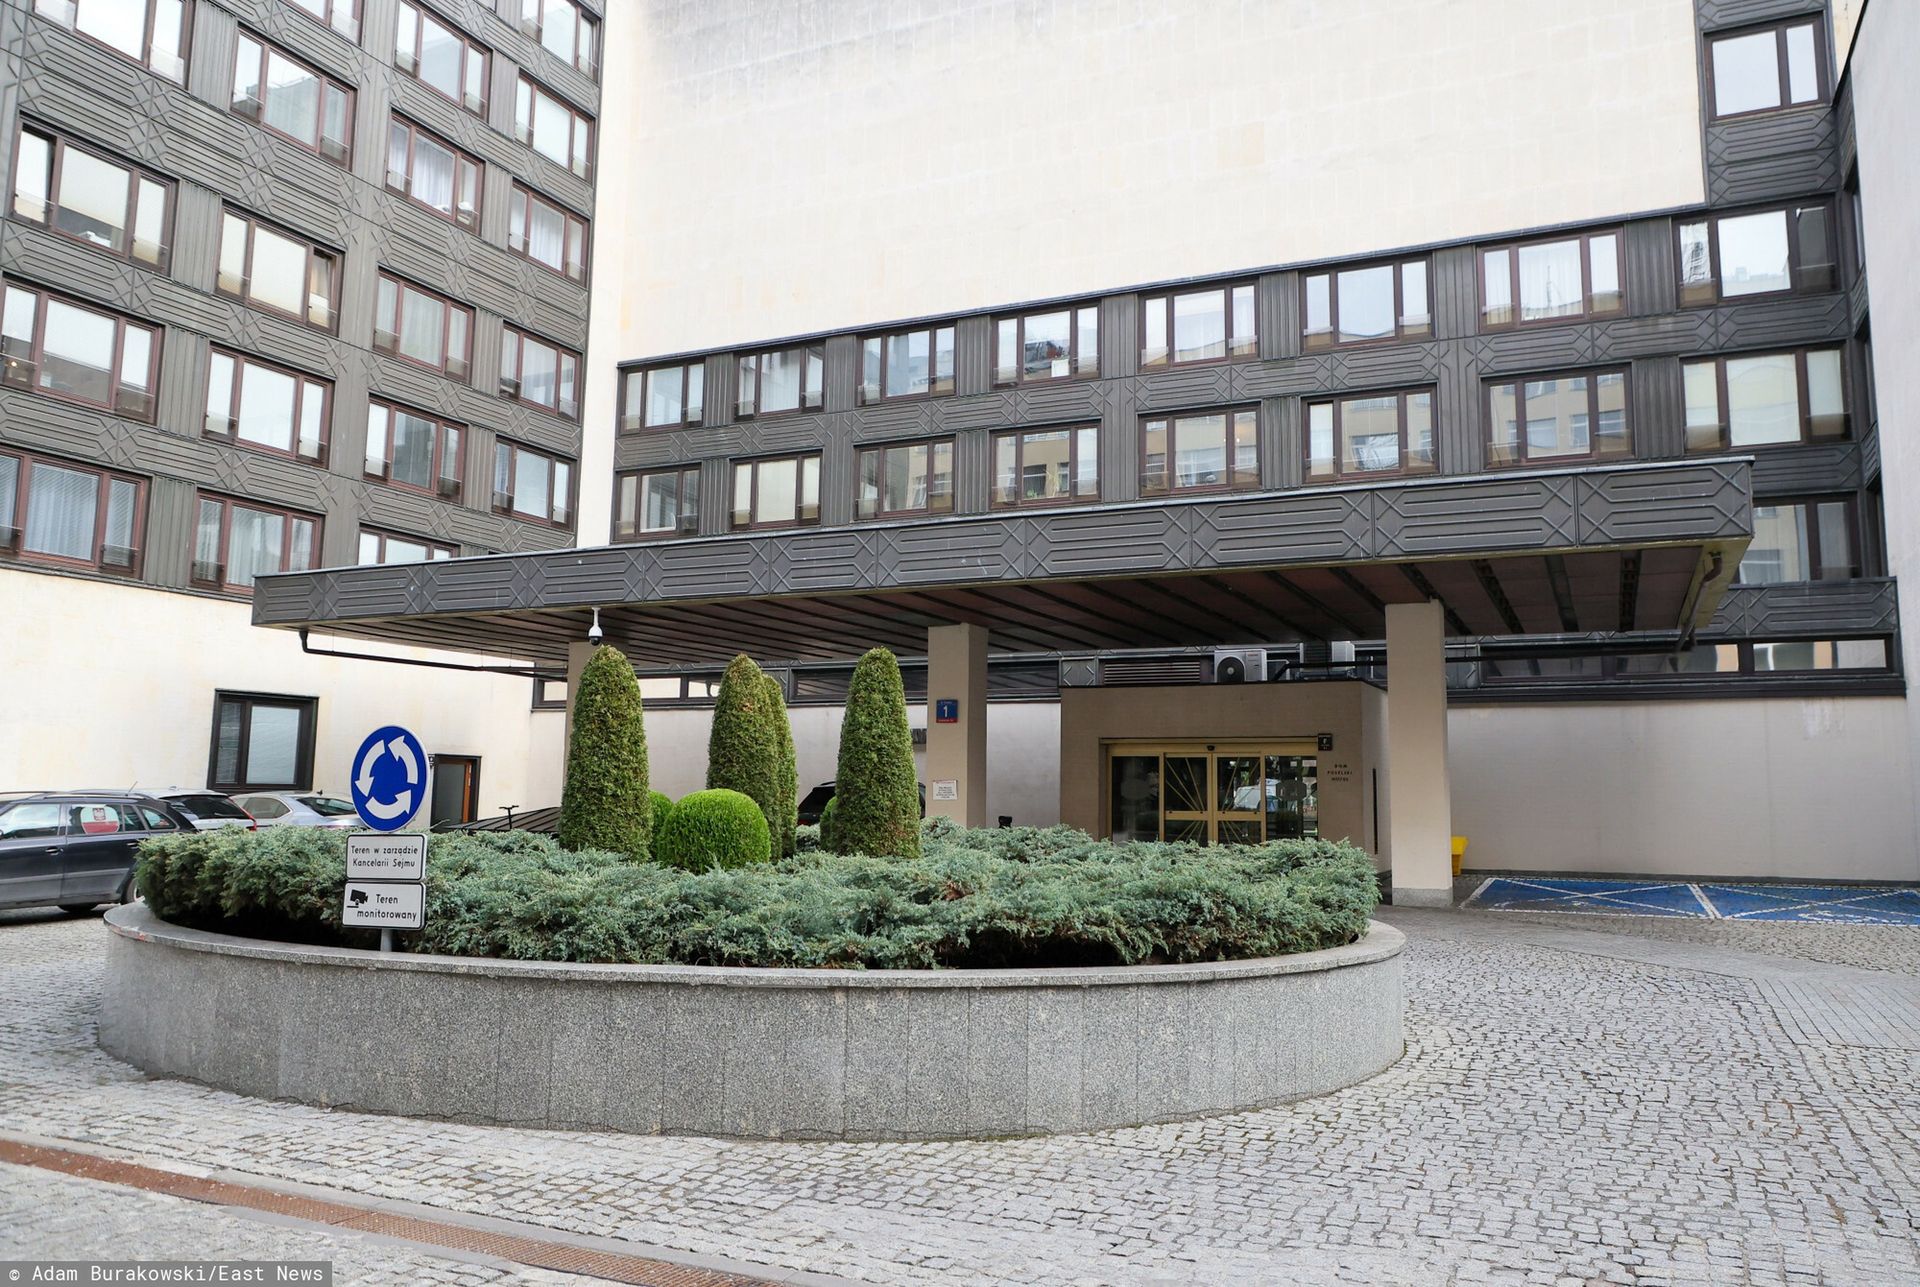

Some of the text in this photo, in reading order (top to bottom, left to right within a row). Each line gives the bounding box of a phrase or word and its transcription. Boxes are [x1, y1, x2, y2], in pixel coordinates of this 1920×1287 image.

[943, 705, 948, 718] 1
[351, 845, 370, 854] Teren
[383, 846, 418, 857] zarządzie
[353, 858, 415, 869] Kancelarii Sejmu
[376, 893, 398, 904] Teren
[357, 908, 417, 922] monitorowany
